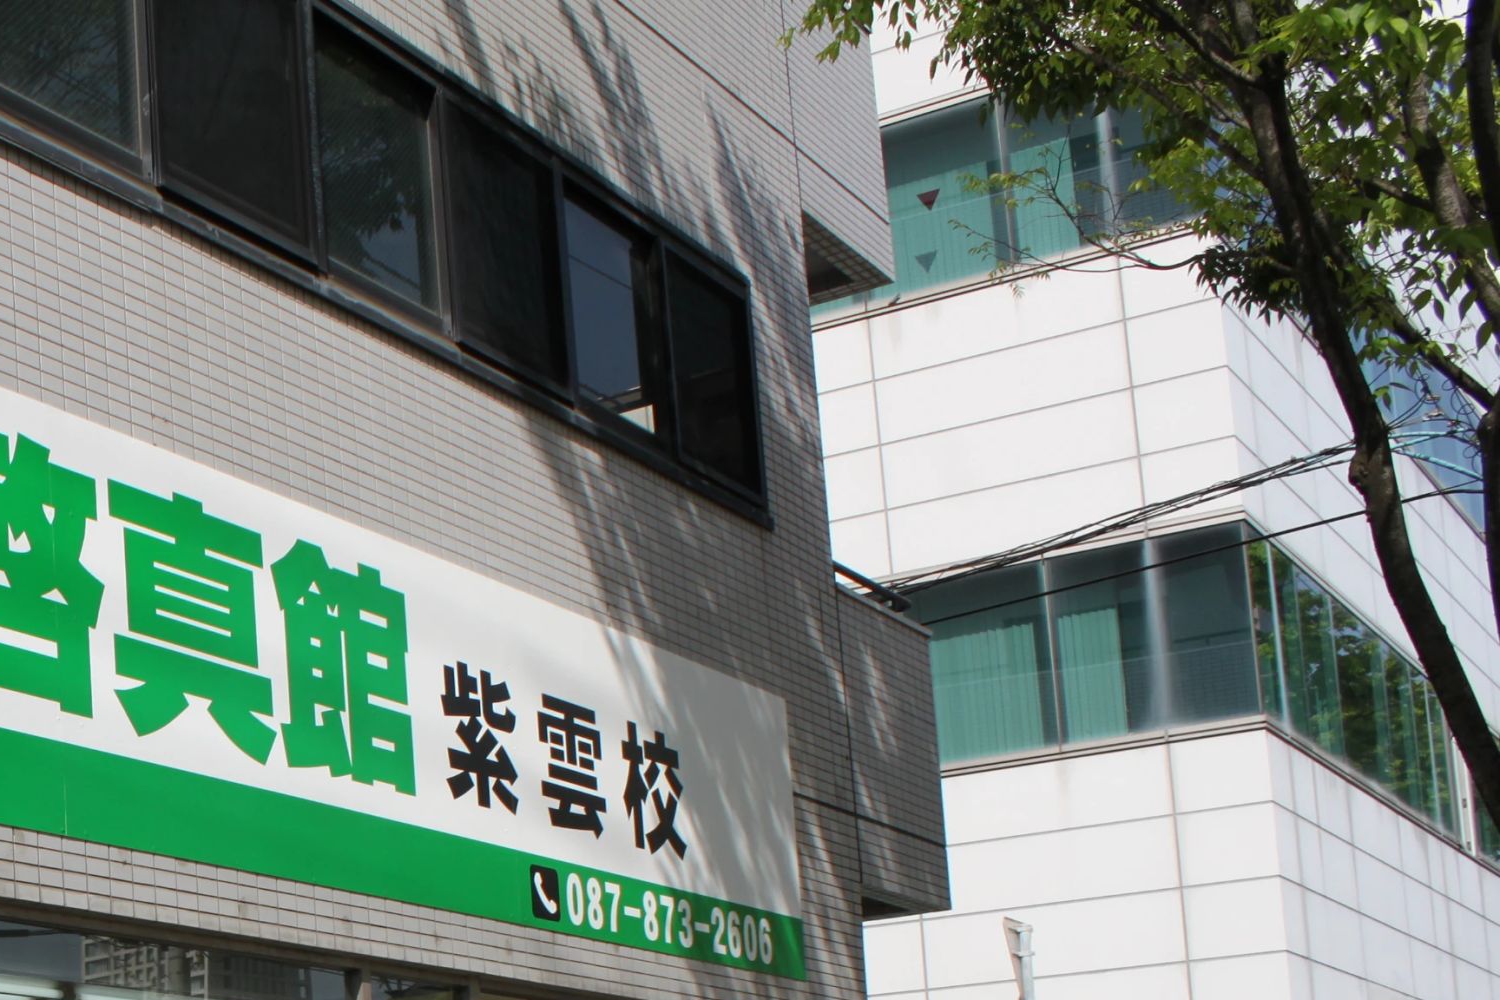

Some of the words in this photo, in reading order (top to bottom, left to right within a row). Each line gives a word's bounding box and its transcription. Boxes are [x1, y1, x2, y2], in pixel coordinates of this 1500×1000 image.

[441, 660, 688, 861] 紫雲校
[566, 872, 773, 965] 087-873-2606
